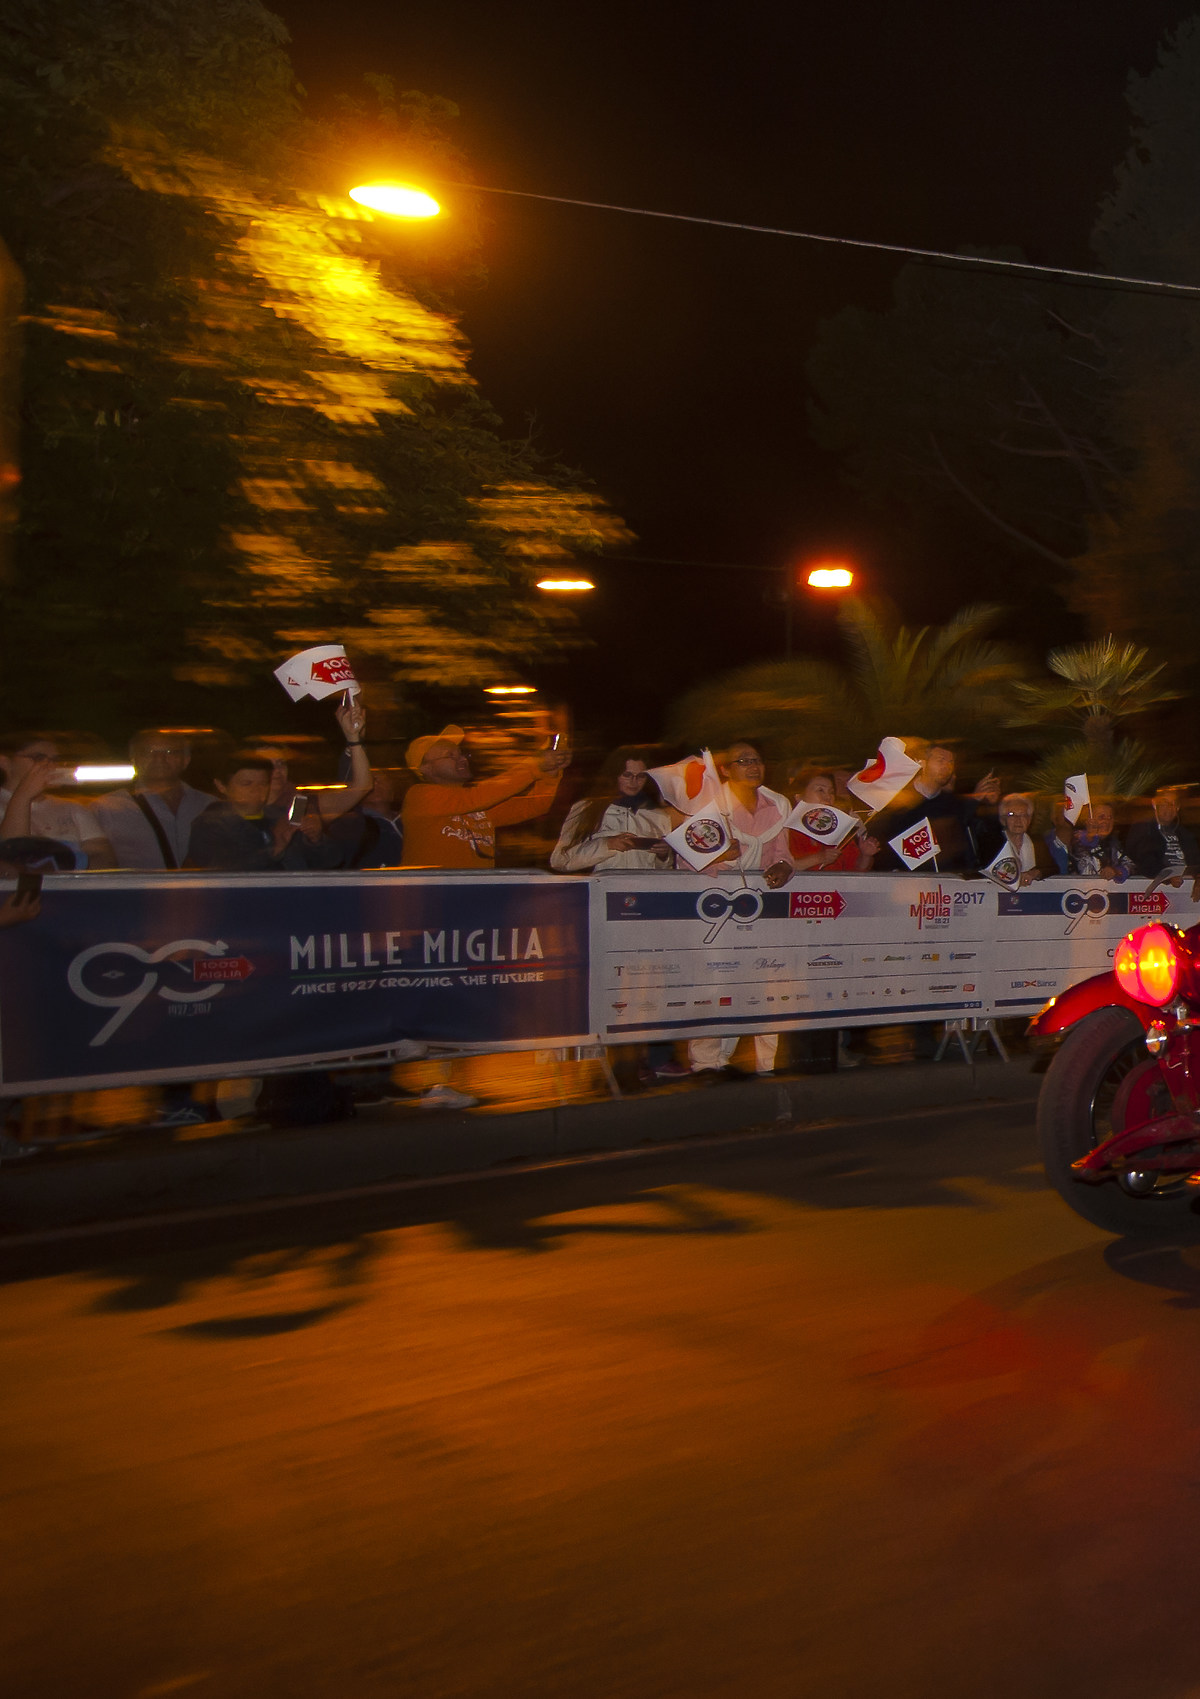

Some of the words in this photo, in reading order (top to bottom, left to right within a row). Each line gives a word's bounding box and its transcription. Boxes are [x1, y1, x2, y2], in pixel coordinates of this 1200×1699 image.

[796, 894, 833, 904] 1000
[919, 884, 951, 904] Mille
[953, 892, 985, 905] 2017
[696, 887, 764, 944] 90
[793, 906, 835, 916] MIGLIA
[909, 904, 951, 930] Miglia
[1061, 888, 1110, 936] 90
[1131, 905, 1162, 913] MIGLIA
[290, 931, 402, 970] MILLE
[423, 928, 544, 964] MIGLIA
[199, 971, 242, 979] MIGLIA
[201, 960, 239, 970] 1000
[291, 982, 336, 995] SINCE
[341, 979, 376, 991] 1927
[459, 975, 487, 985] THE
[492, 972, 544, 984] FUTURE
